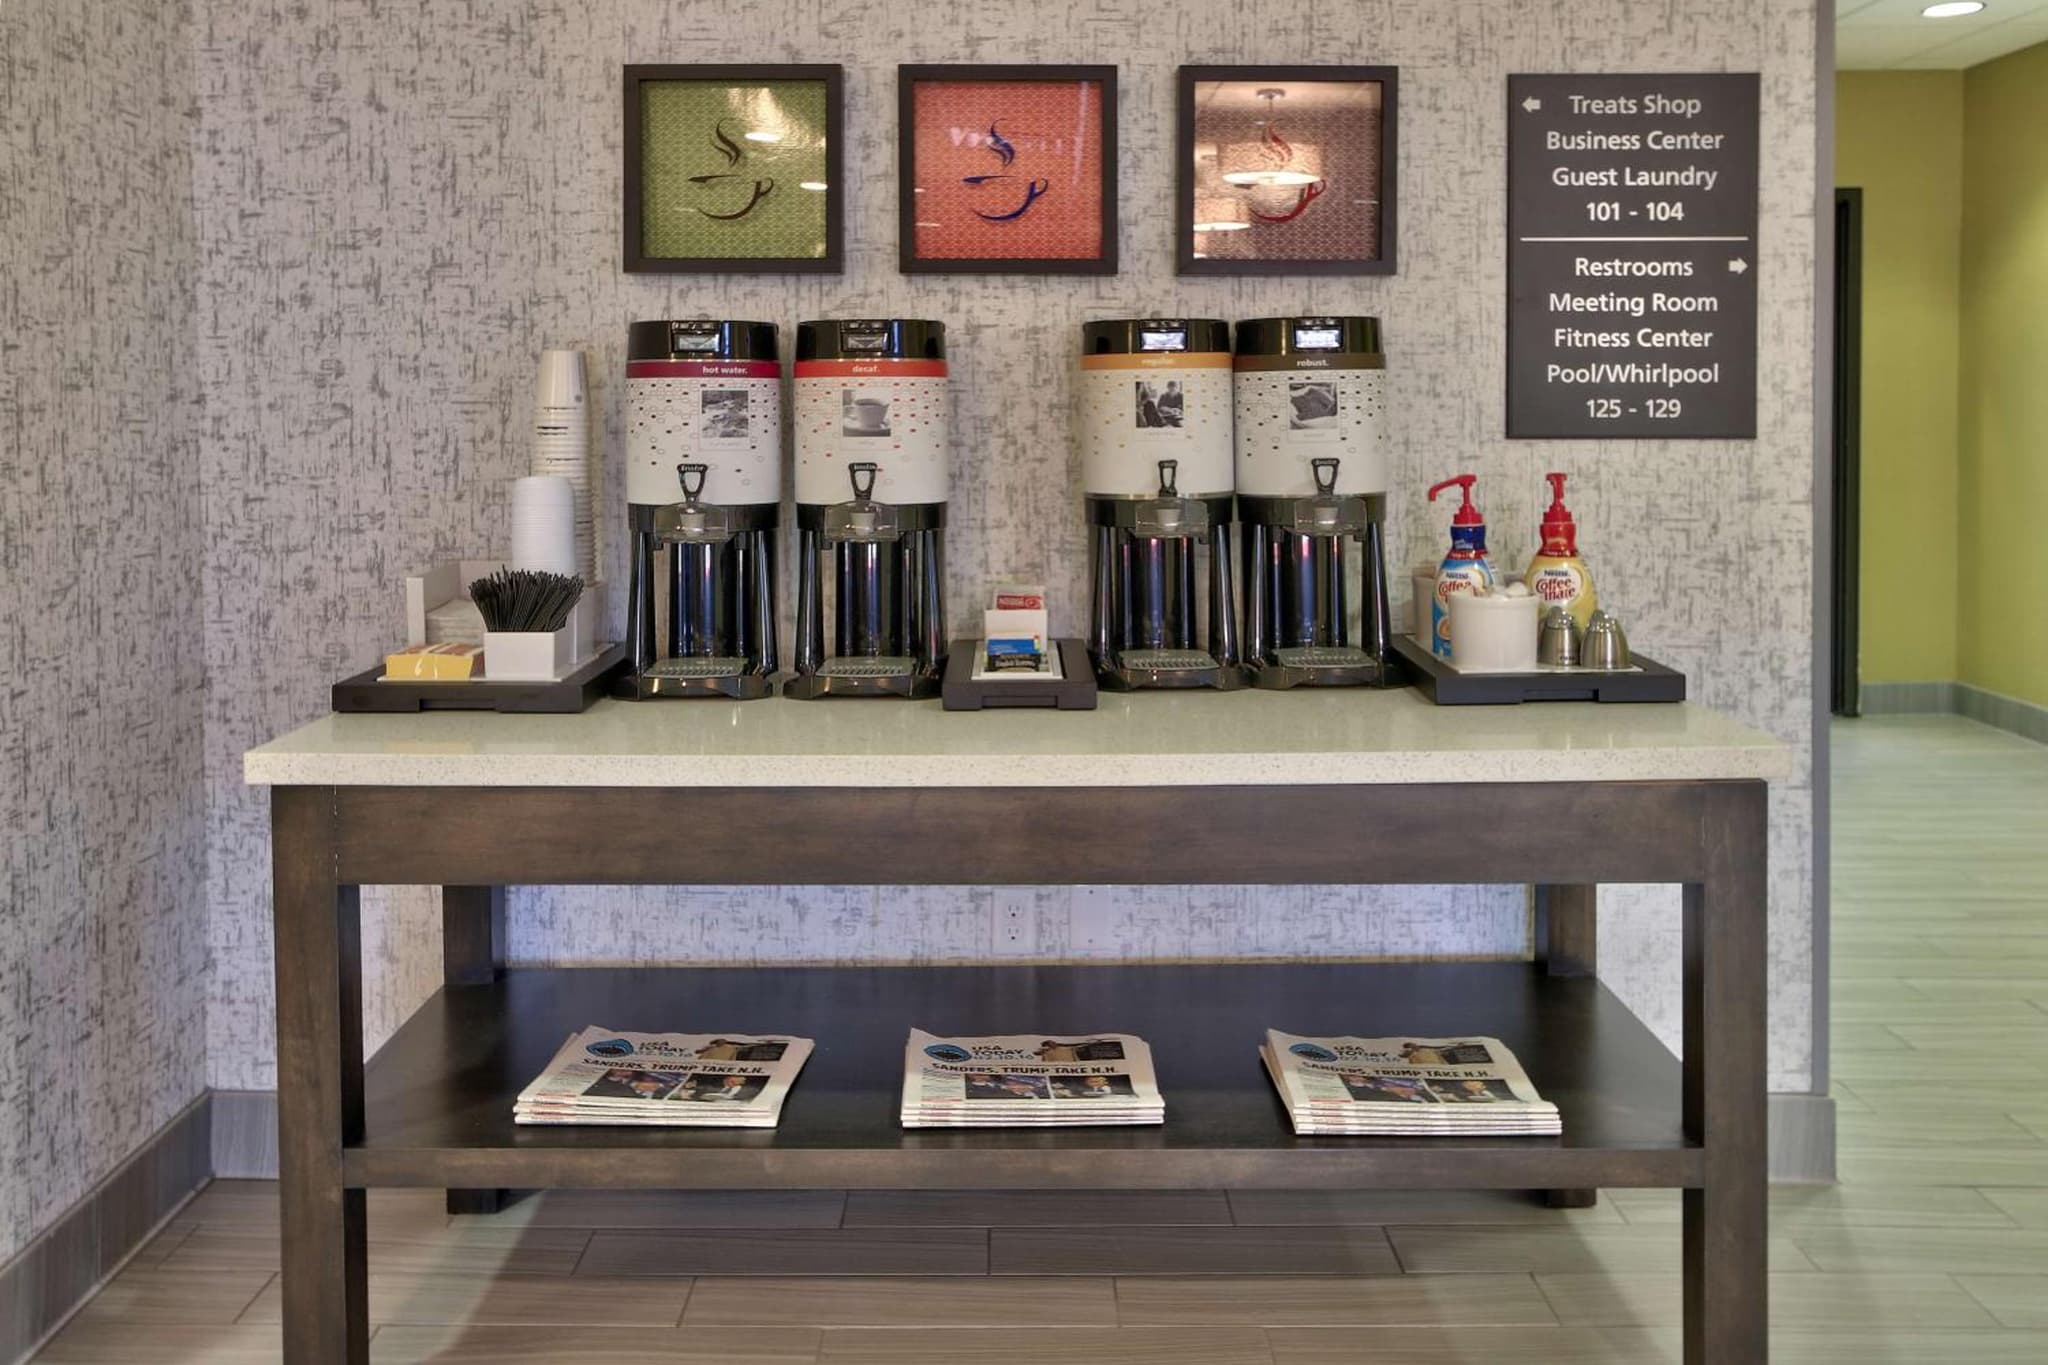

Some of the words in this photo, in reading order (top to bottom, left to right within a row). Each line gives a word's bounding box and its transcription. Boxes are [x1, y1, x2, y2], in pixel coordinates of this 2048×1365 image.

[1569, 94, 1637, 115] Treats
[1644, 94, 1701, 118] Shop
[1547, 131, 1640, 151] Business
[1647, 131, 1724, 151] Center
[1552, 166, 1618, 187] Guest
[1625, 166, 1717, 190] Laundry
[1587, 202, 1620, 221] 101
[1646, 202, 1684, 221] 104
[1576, 258, 1693, 276] Restrooms
[1550, 292, 1644, 317] Meeting
[1652, 292, 1718, 312] Room
[1555, 328, 1630, 347] Fitness
[1637, 328, 1713, 347] Center
[703, 366, 719, 374] hot
[1548, 363, 1719, 388] Pool/Whirlpool
[1587, 399, 1621, 418] 125
[1646, 399, 1682, 418] 129
[651, 1063, 698, 1072] TRUMP
[702, 1065, 737, 1073] TAKE
[1002, 1066, 1050, 1075] TRUMP
[1374, 1068, 1421, 1077] TRUMP
[1426, 1070, 1460, 1078] TAKE
